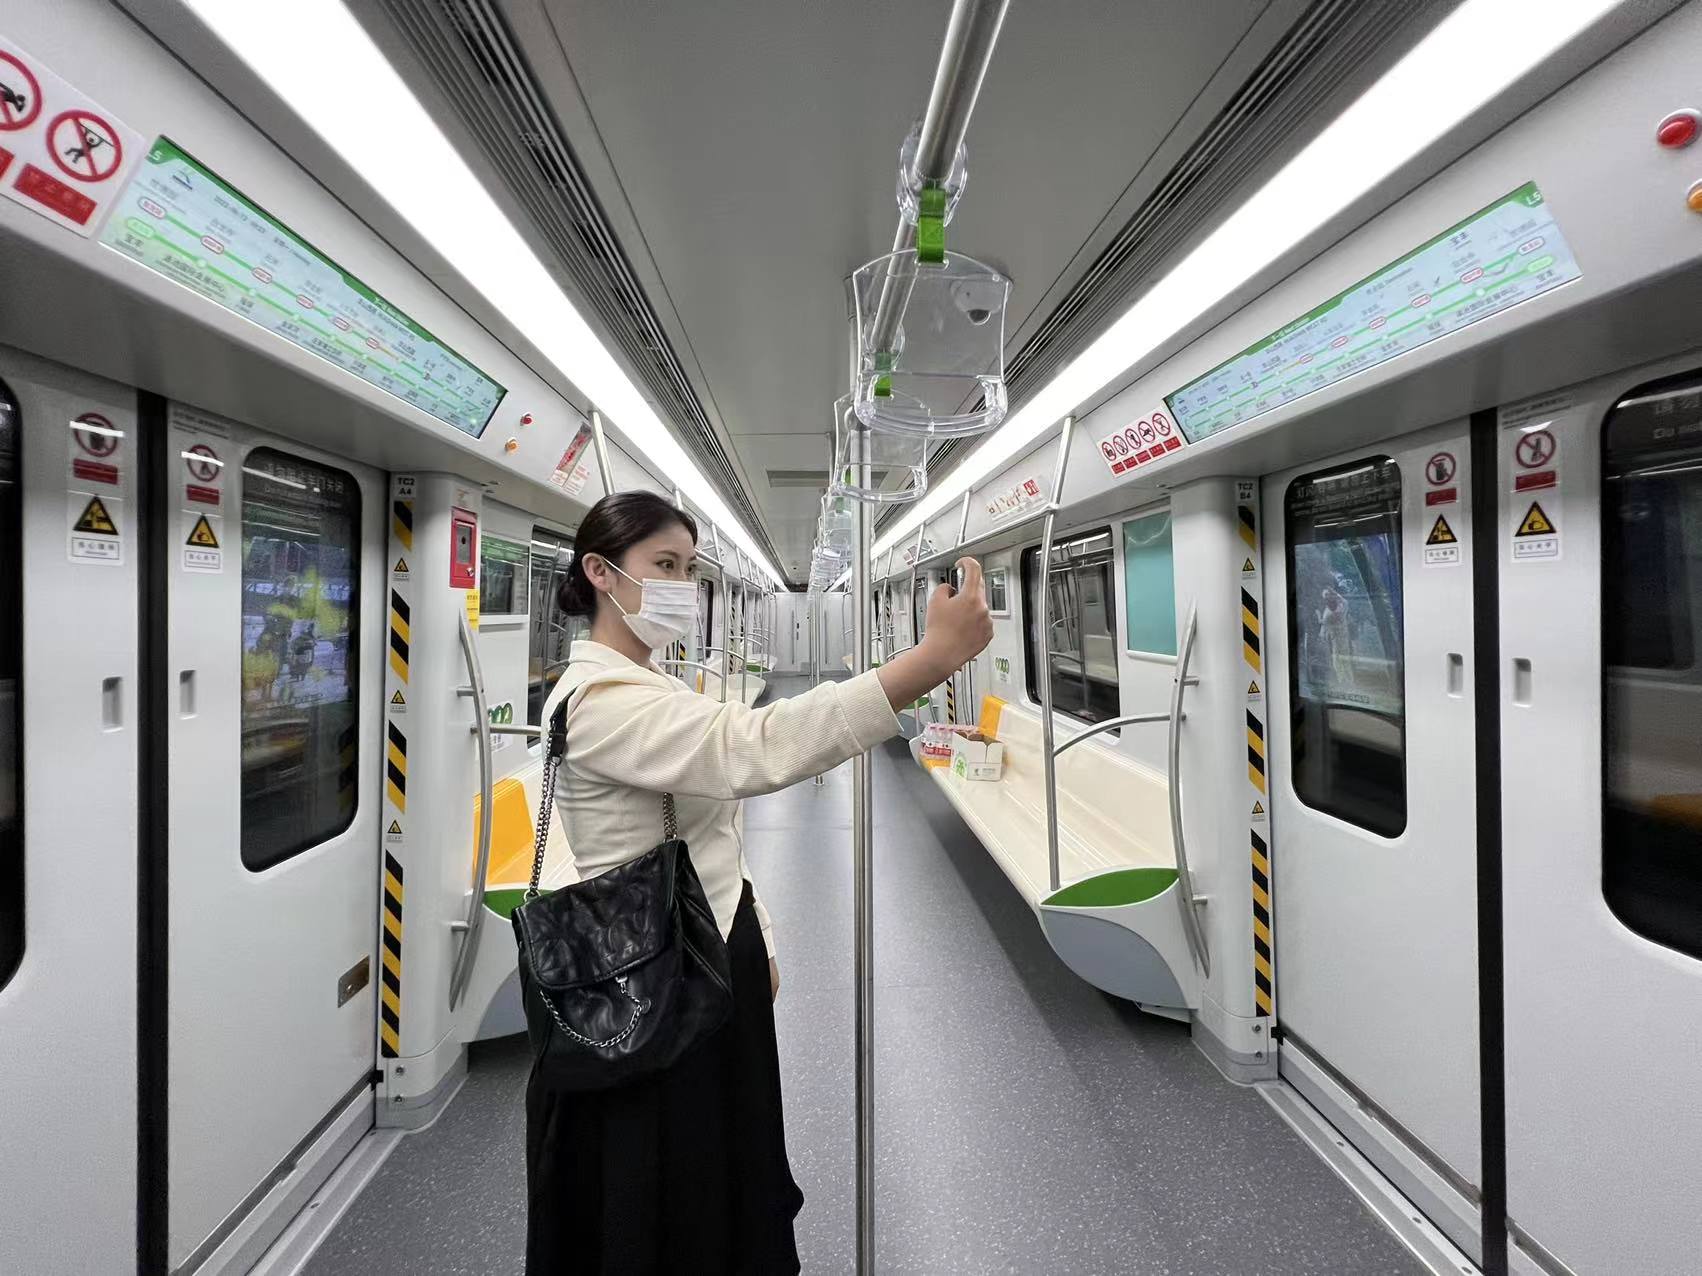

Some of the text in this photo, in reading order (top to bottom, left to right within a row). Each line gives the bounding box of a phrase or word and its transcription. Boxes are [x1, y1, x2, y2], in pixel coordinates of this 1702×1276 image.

[1526, 191, 1541, 205] L5
[398, 477, 415, 486] TC2
[1238, 482, 1254, 490] TC2
[399, 487, 412, 495] A4
